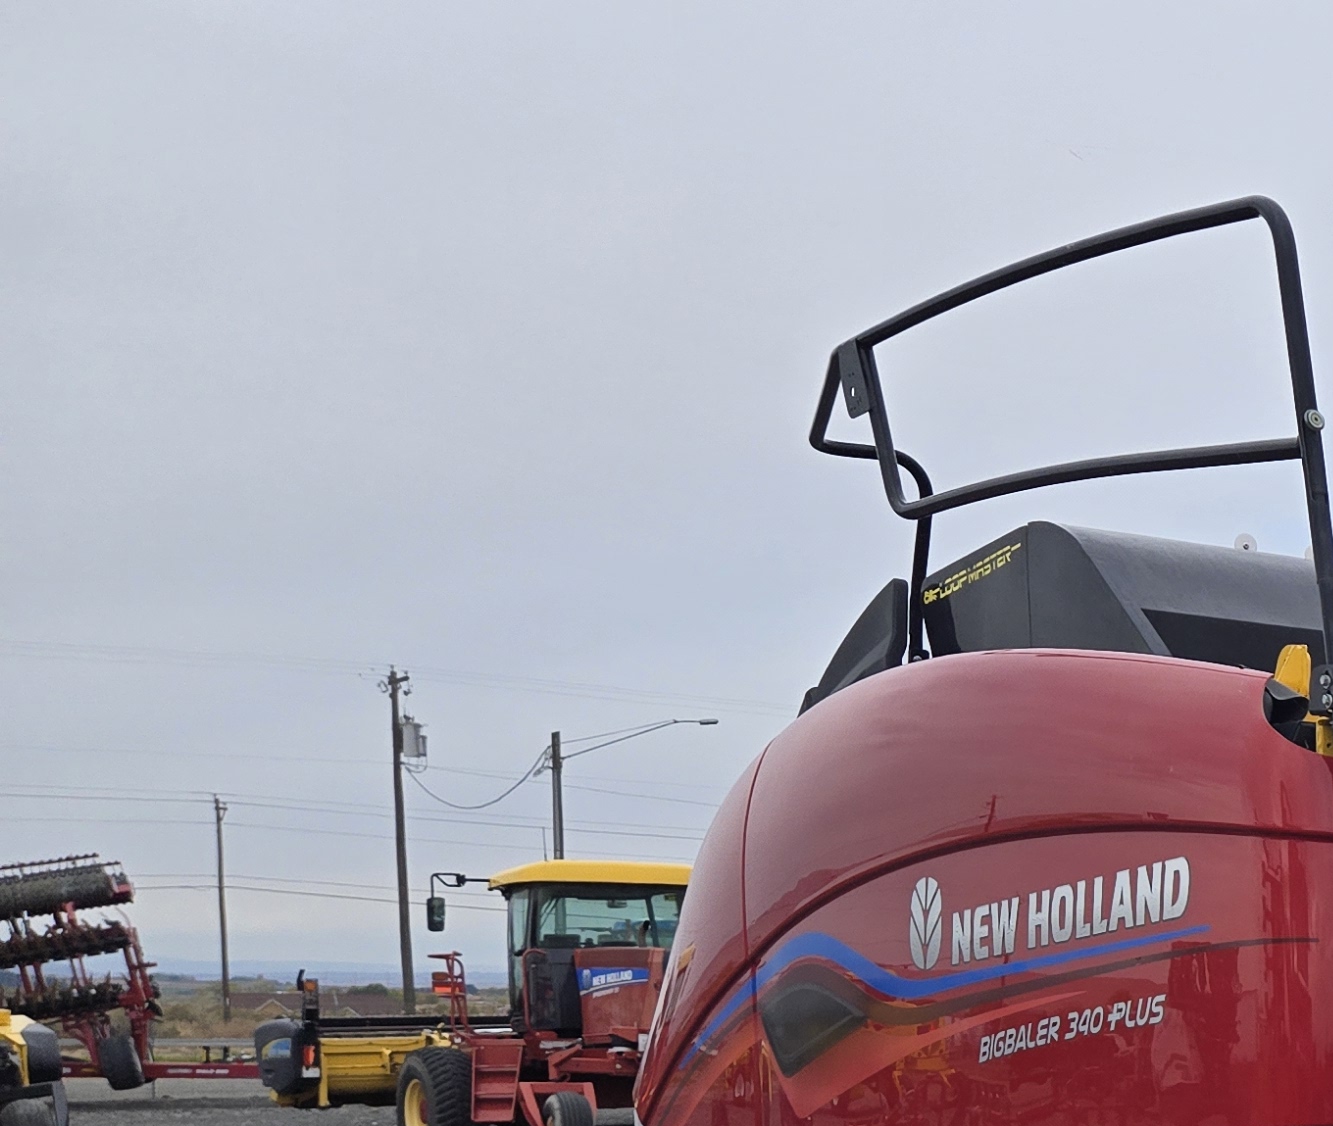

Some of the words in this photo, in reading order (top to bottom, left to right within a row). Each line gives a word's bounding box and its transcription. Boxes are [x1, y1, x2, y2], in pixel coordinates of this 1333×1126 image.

[951, 896, 1020, 965] NEW
[1027, 856, 1190, 949] HOLLAND
[978, 1015, 1061, 1063] BIGBALER
[1064, 1006, 1104, 1040] 340
